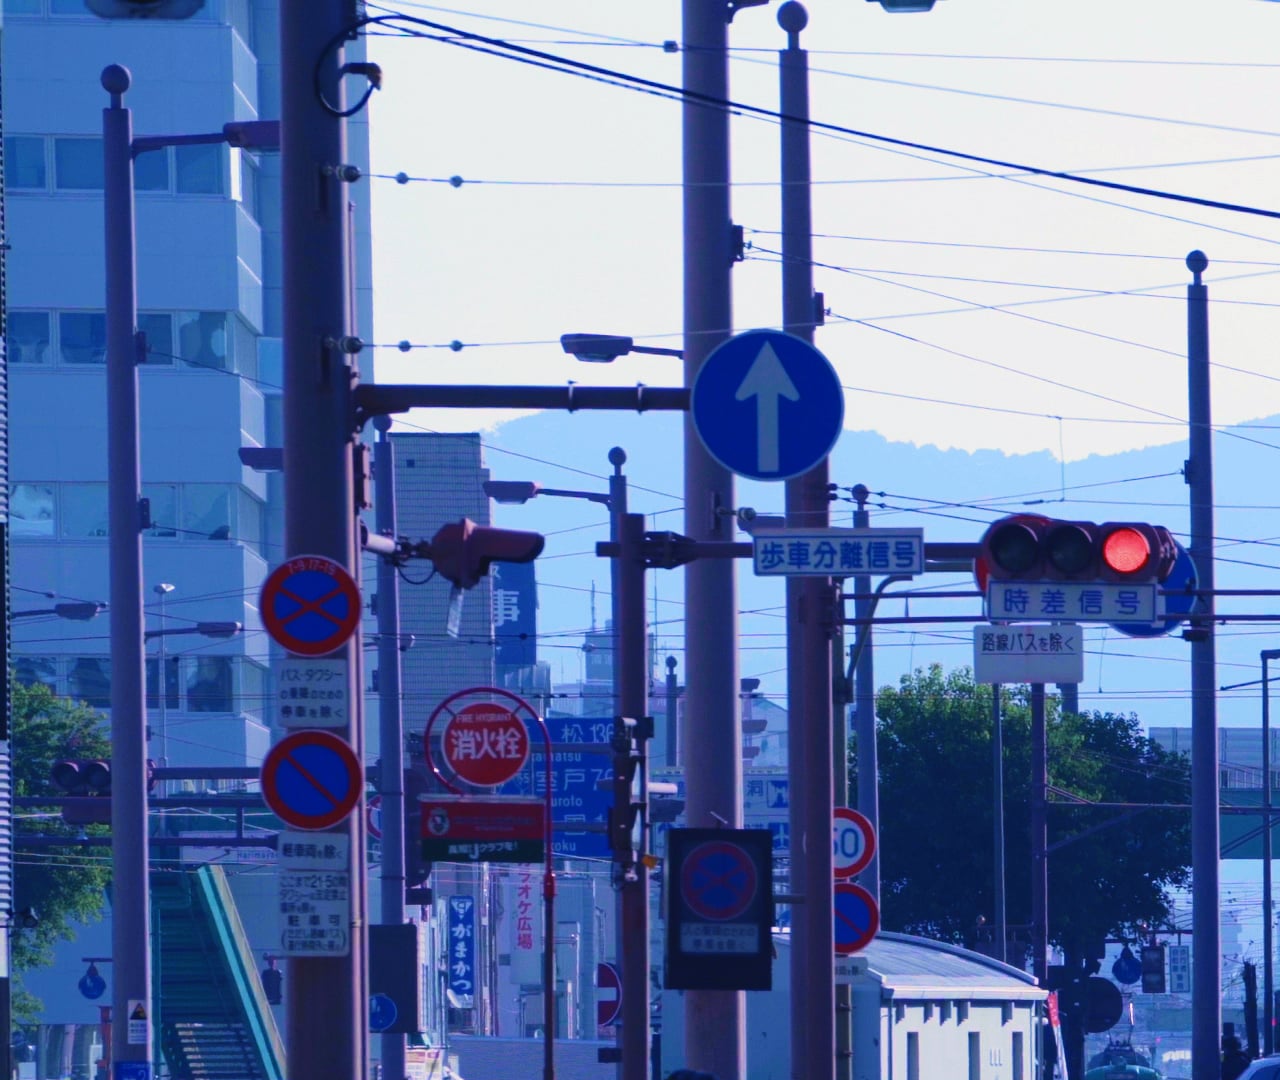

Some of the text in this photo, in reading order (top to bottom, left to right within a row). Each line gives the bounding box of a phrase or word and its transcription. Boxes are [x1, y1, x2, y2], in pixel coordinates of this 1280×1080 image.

[761, 541, 915, 569] 歩車分離信号
[1003, 588, 1140, 615] 時差信号
[982, 632, 1075, 652] 路線バスを除く
[456, 712, 513, 723] FIRE HYDRANT
[452, 728, 522, 761] 消火栓
[451, 922, 473, 992] がまかつ
